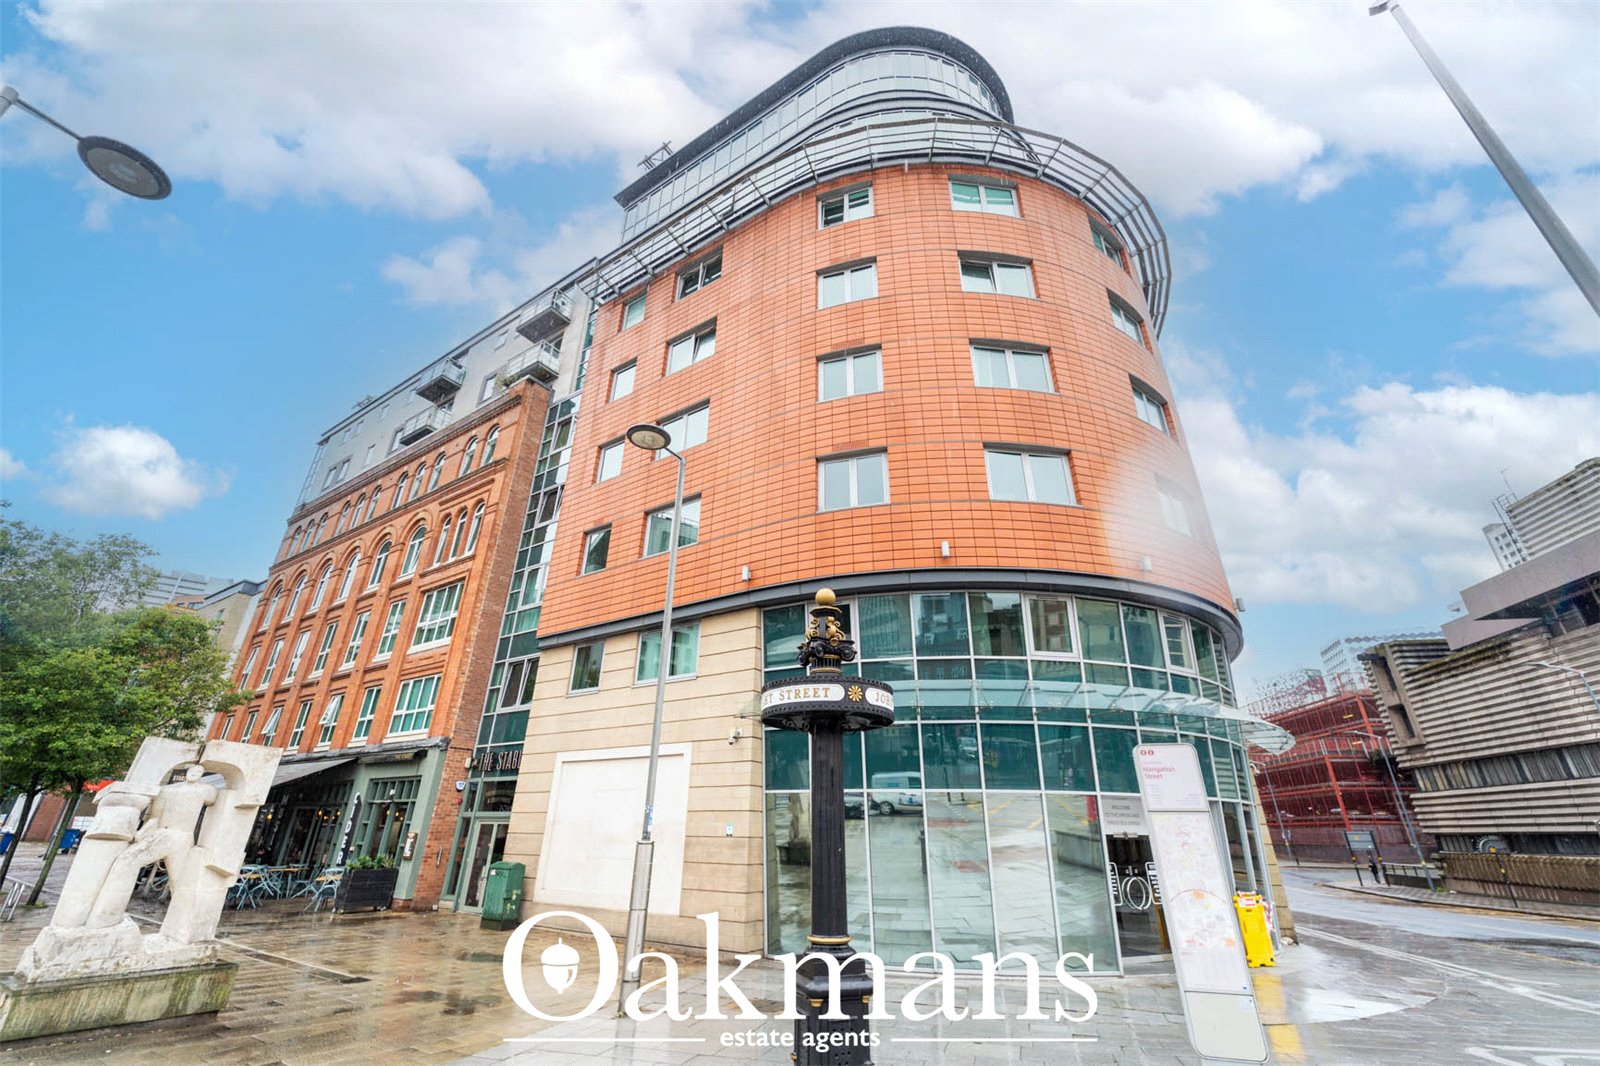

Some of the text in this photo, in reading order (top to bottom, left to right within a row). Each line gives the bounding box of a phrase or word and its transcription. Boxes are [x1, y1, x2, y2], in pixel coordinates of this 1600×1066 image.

[779, 687, 830, 701] STREET
[479, 752, 494, 771] THE
[1142, 766, 1176, 774] Navigation
[336, 792, 361, 865] CIDER
